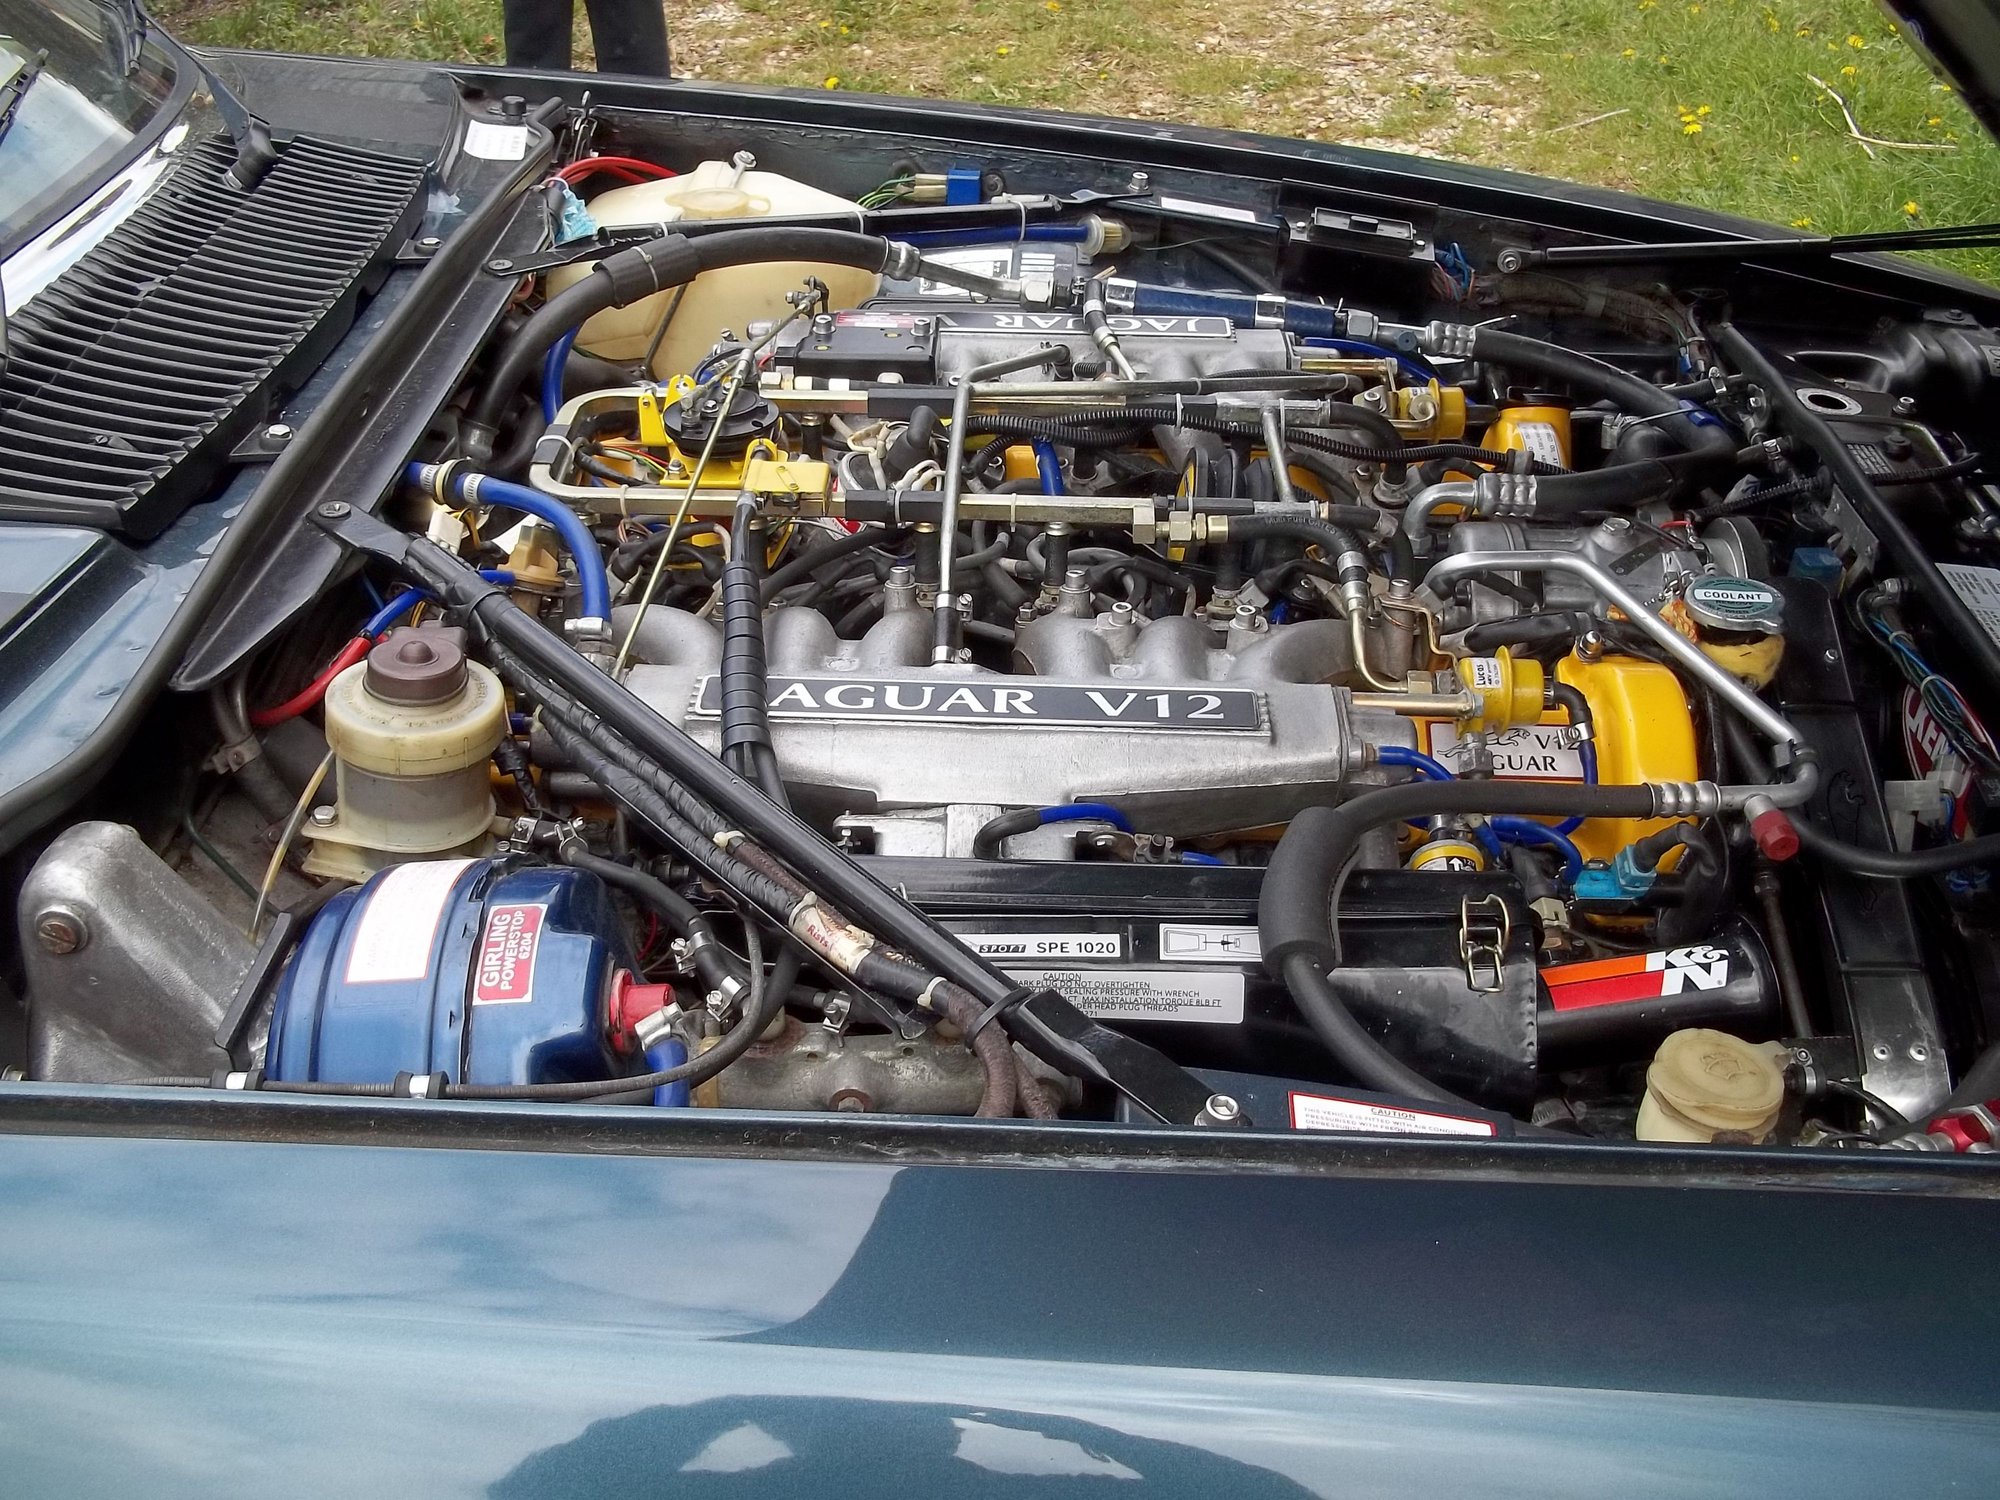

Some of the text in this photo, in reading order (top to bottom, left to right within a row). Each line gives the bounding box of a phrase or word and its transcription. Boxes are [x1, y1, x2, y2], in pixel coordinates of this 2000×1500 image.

[1703, 591, 1762, 601] COOLANT
[768, 681, 1225, 720] AGUAR V12
[1492, 754, 1559, 772] GUAR
[481, 913, 512, 987] GIRLING
[500, 910, 526, 991] POWERSTOP
[518, 931, 534, 960] 6204
[1036, 941, 1070, 954] SPE
[1076, 941, 1116, 954] 1020
[1042, 972, 1082, 981] CAUTION
[1094, 980, 1150, 989] OVERTIGHTEN
[1064, 987, 1098, 996] SEALING
[1099, 988, 1140, 996] PRESSURE
[1142, 989, 1163, 997] WITH
[1164, 990, 1200, 998] WRENCH
[1101, 996, 1158, 1005] INSTALLATION
[1160, 997, 1193, 1006] TORQUE
[1142, 1004, 1179, 1012] THREADS
[1305, 1113, 1357, 1126] PRESSURISED
[1323, 1110, 1354, 1119] VEHICLE
[1364, 1116, 1390, 1125] FITTED
[1371, 1107, 1416, 1120] CAUTION
